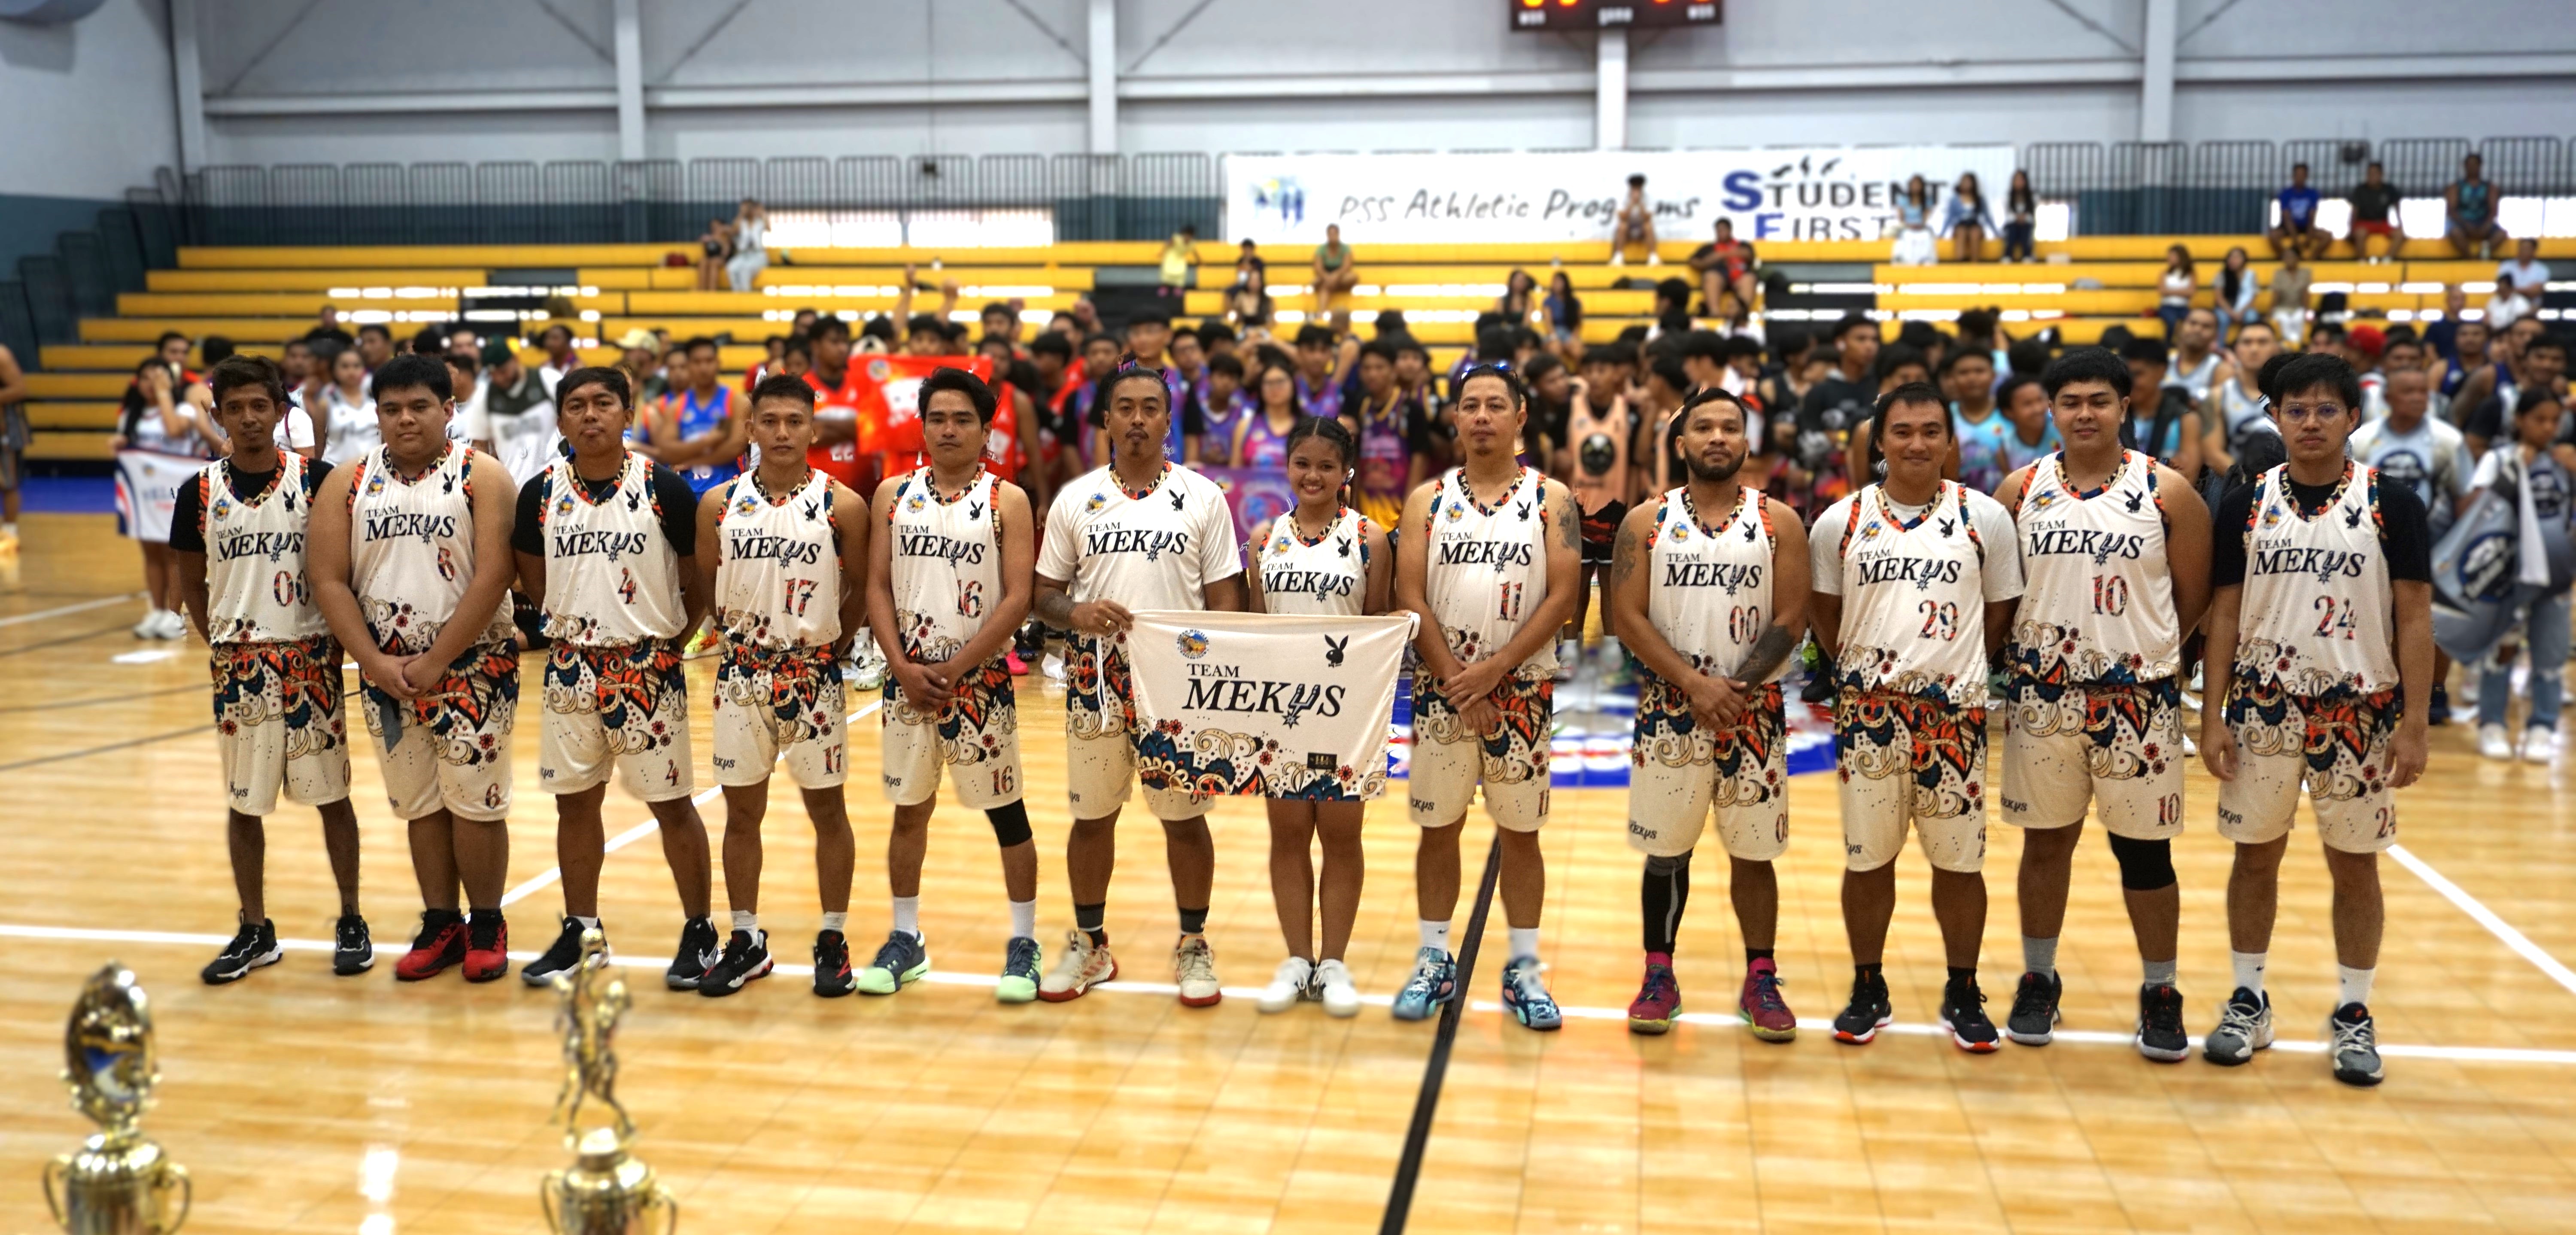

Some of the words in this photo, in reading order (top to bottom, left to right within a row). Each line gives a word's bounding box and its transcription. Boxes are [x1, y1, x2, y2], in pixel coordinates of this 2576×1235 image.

[1339, 196, 1395, 222] PSS
[1404, 189, 1530, 219] Athletic
[1543, 189, 1700, 226] Progms
[365, 505, 400, 517] TEAM
[217, 526, 242, 539] TEAM
[553, 524, 584, 534] TEAM
[730, 528, 763, 537] TEAM
[899, 525, 930, 534] TEAM
[1087, 522, 1121, 533] TEAM
[1440, 532, 1473, 541] TEAM
[2029, 520, 2066, 532] TEAM
[1666, 553, 1701, 562] TEAM
[1859, 549, 1891, 560] TEAM
[2257, 538, 2292, 549] TEAM
[437, 547, 455, 581] 6
[1266, 562, 1293, 571] TEAM
[274, 570, 310, 607] 00
[618, 567, 636, 605] 4
[781, 578, 819, 618] 17
[957, 579, 982, 619] 16
[2092, 574, 2128, 617] 10
[1496, 581, 1523, 622] 11
[1729, 605, 1759, 645] 00
[1918, 599, 1958, 642] 29
[2312, 595, 2357, 640] 24
[1187, 663, 1241, 678] TEAM
[665, 759, 679, 787] 4
[823, 742, 843, 776] 17
[991, 765, 1014, 796] 16
[486, 783, 500, 809] 6
[2156, 792, 2180, 827] 10
